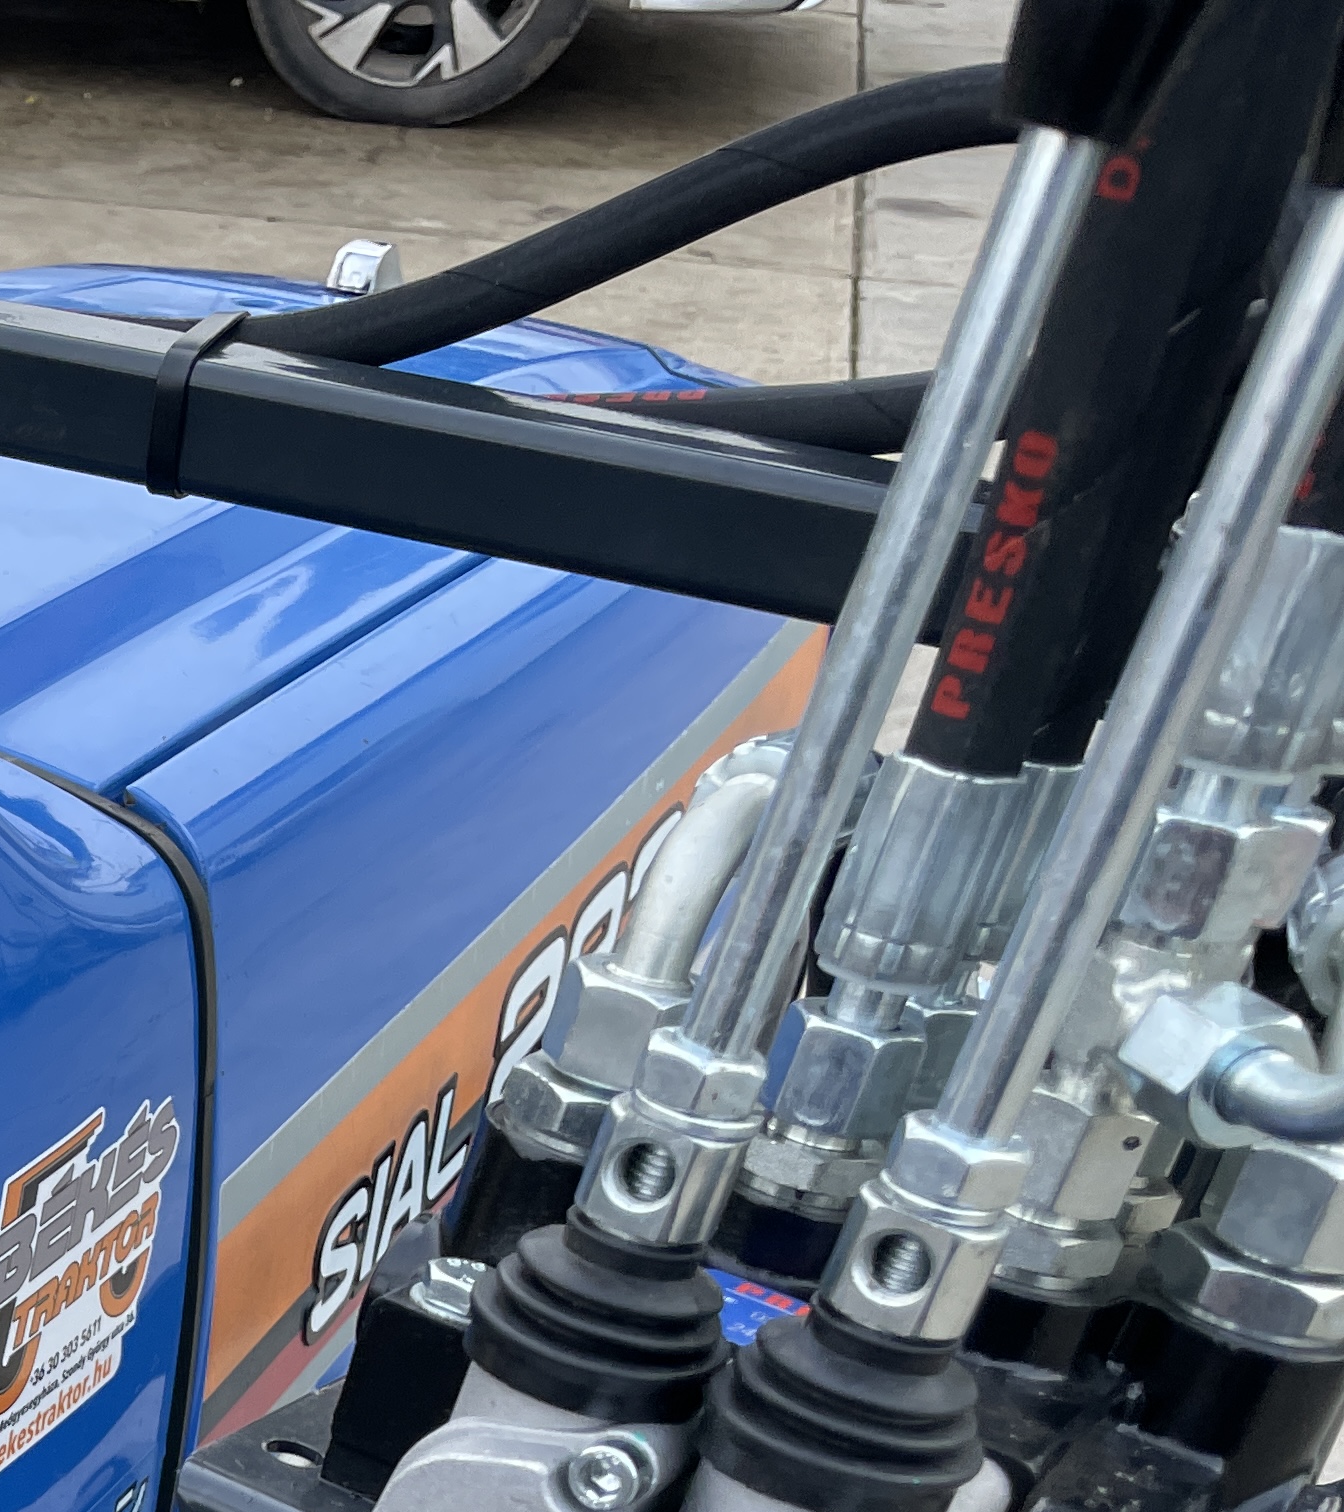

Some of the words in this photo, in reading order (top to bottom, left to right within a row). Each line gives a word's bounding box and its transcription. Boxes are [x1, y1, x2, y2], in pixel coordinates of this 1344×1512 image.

[931, 430, 1058, 720] PRESKO
[12, 1191, 159, 1351] TRAKTOR
[303, 1074, 473, 1345] SIAL
[47, 1352, 60, 1374] 30
[61, 1335, 79, 1363] 303
[80, 1315, 102, 1347] 5611
